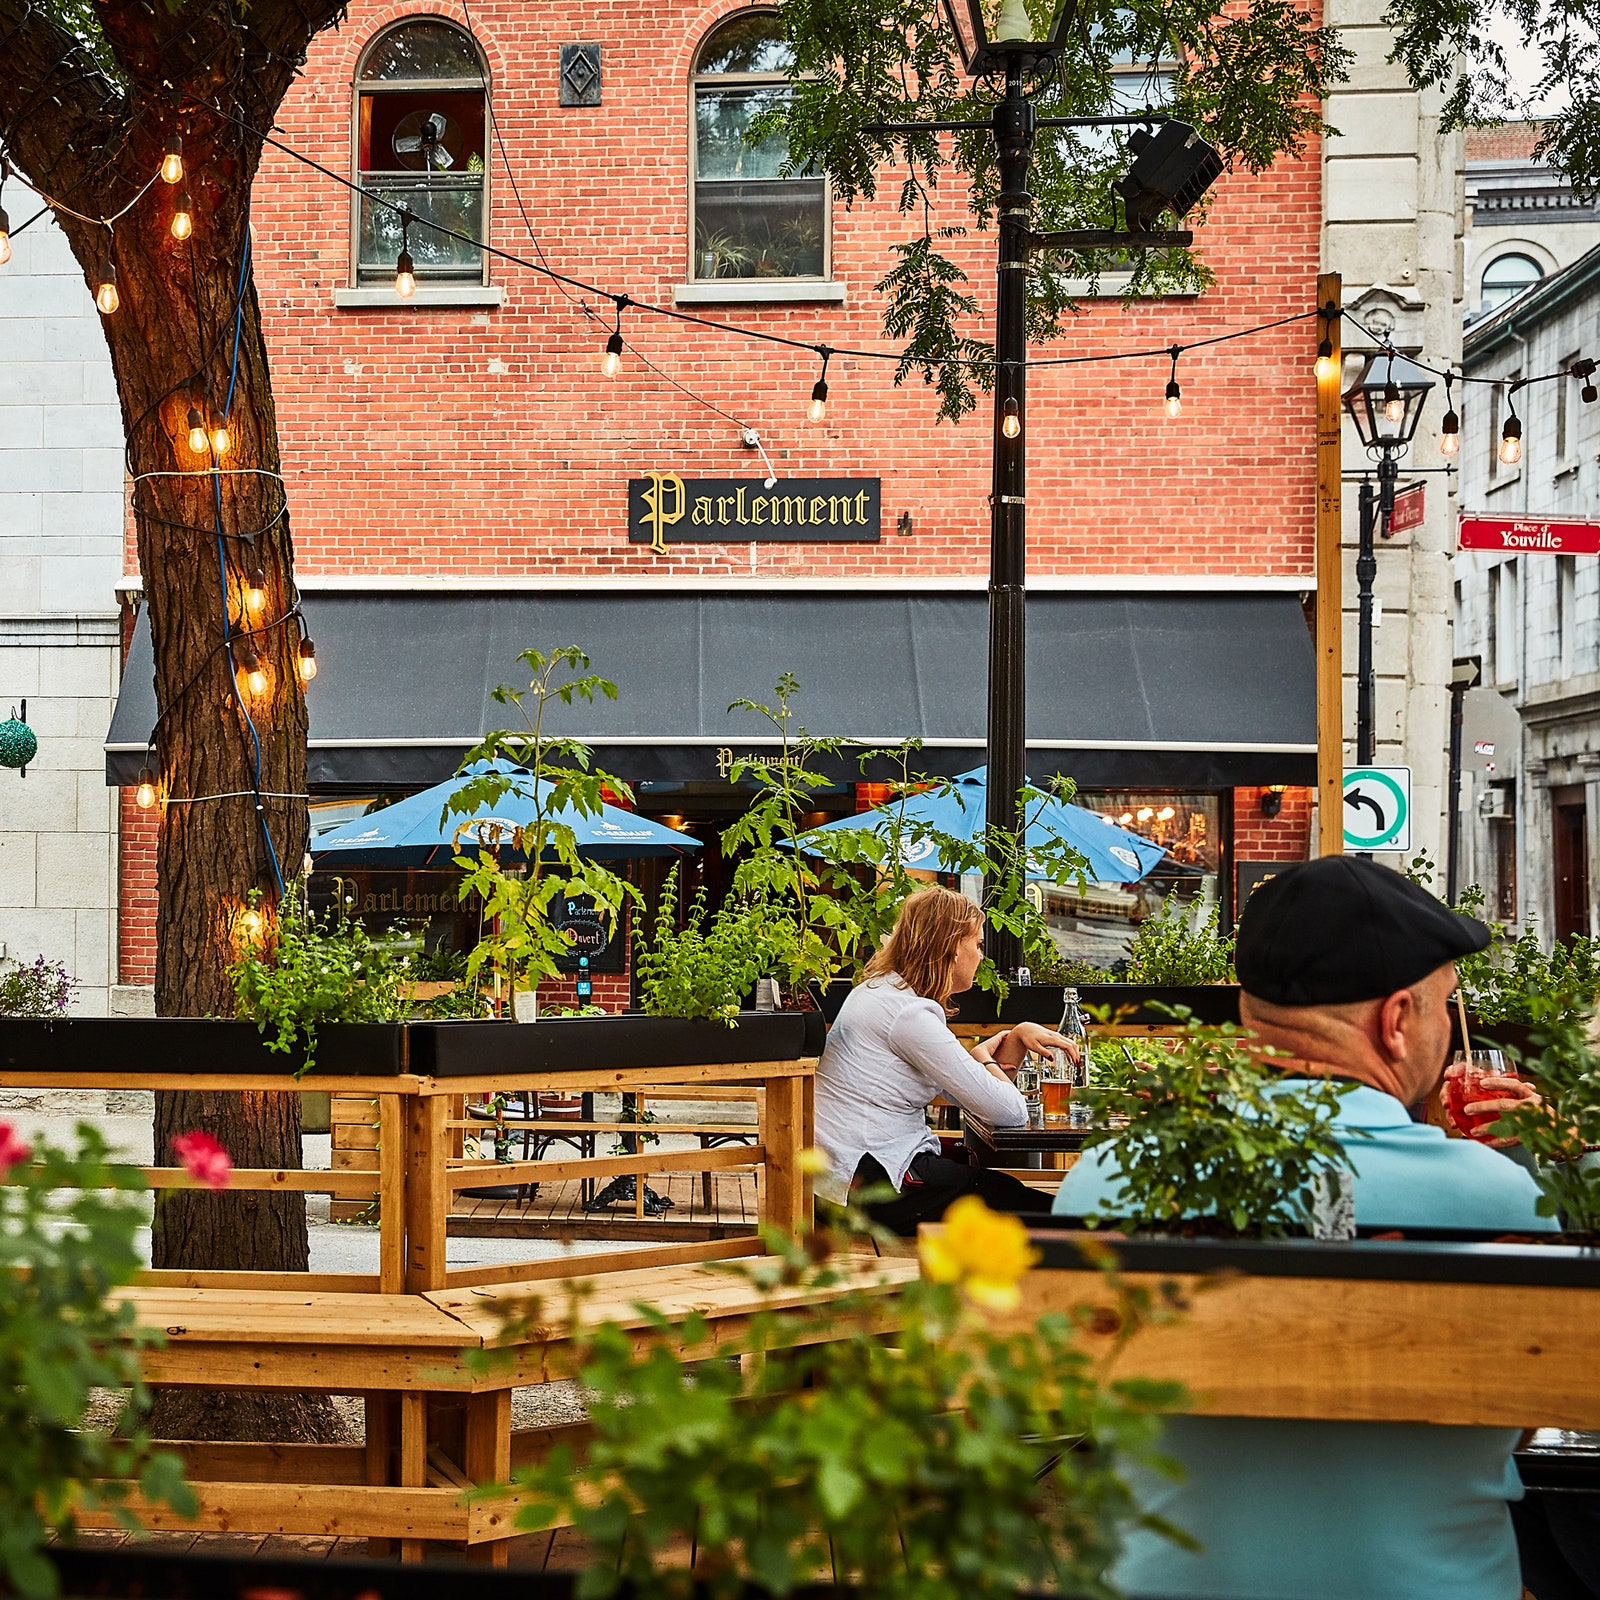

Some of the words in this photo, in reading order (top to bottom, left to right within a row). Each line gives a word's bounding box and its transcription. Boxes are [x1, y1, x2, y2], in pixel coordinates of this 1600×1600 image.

[638, 471, 871, 554] Parlement
[1513, 523, 1538, 532] Place
[1500, 531, 1563, 548] Youville
[331, 876, 479, 925] Parlement
